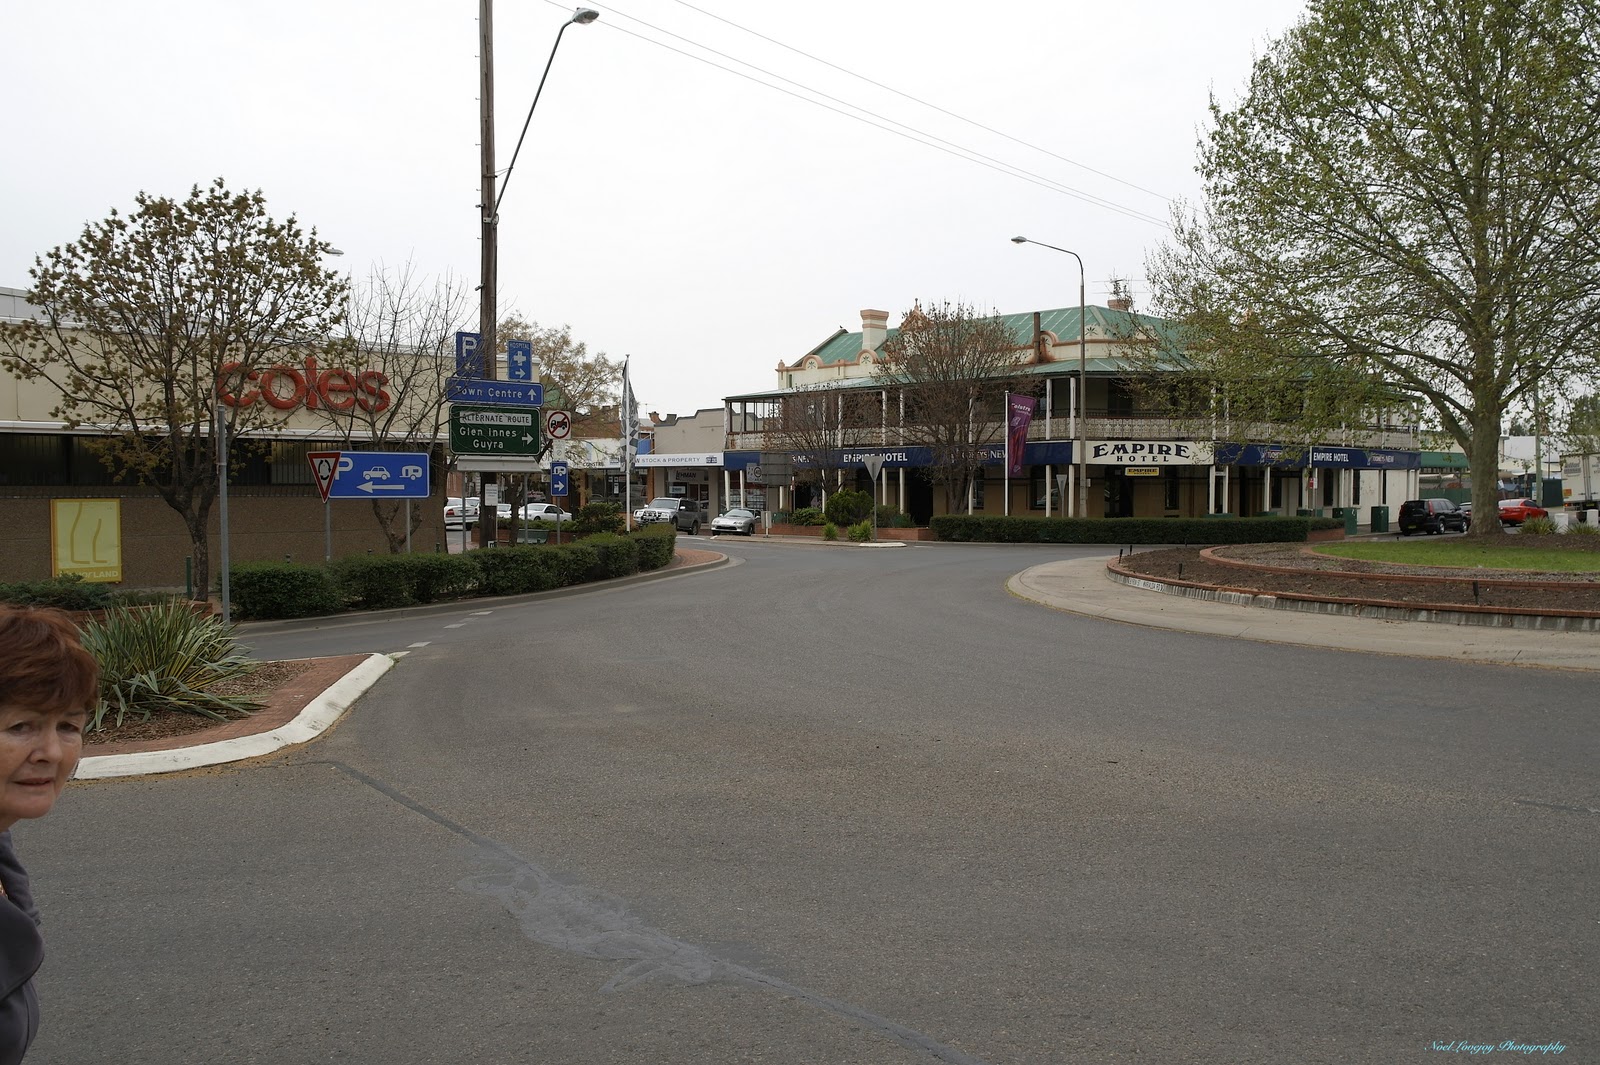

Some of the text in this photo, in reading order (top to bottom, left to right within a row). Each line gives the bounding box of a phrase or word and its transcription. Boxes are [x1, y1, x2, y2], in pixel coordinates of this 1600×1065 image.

[462, 336, 477, 358] P
[509, 342, 530, 350] HOSPITAL
[216, 355, 390, 412] coles
[456, 386, 523, 399] Town Centre
[462, 413, 530, 424] ALTERNATE ROUTE
[459, 427, 517, 438] Glen Innes
[473, 439, 504, 450] Guyra
[1093, 443, 1190, 459] EMPIRE
[1116, 455, 1170, 463] HOTEL
[1313, 452, 1349, 462] EMPIRE HOTEL
[676, 471, 697, 480] LEHMAN
